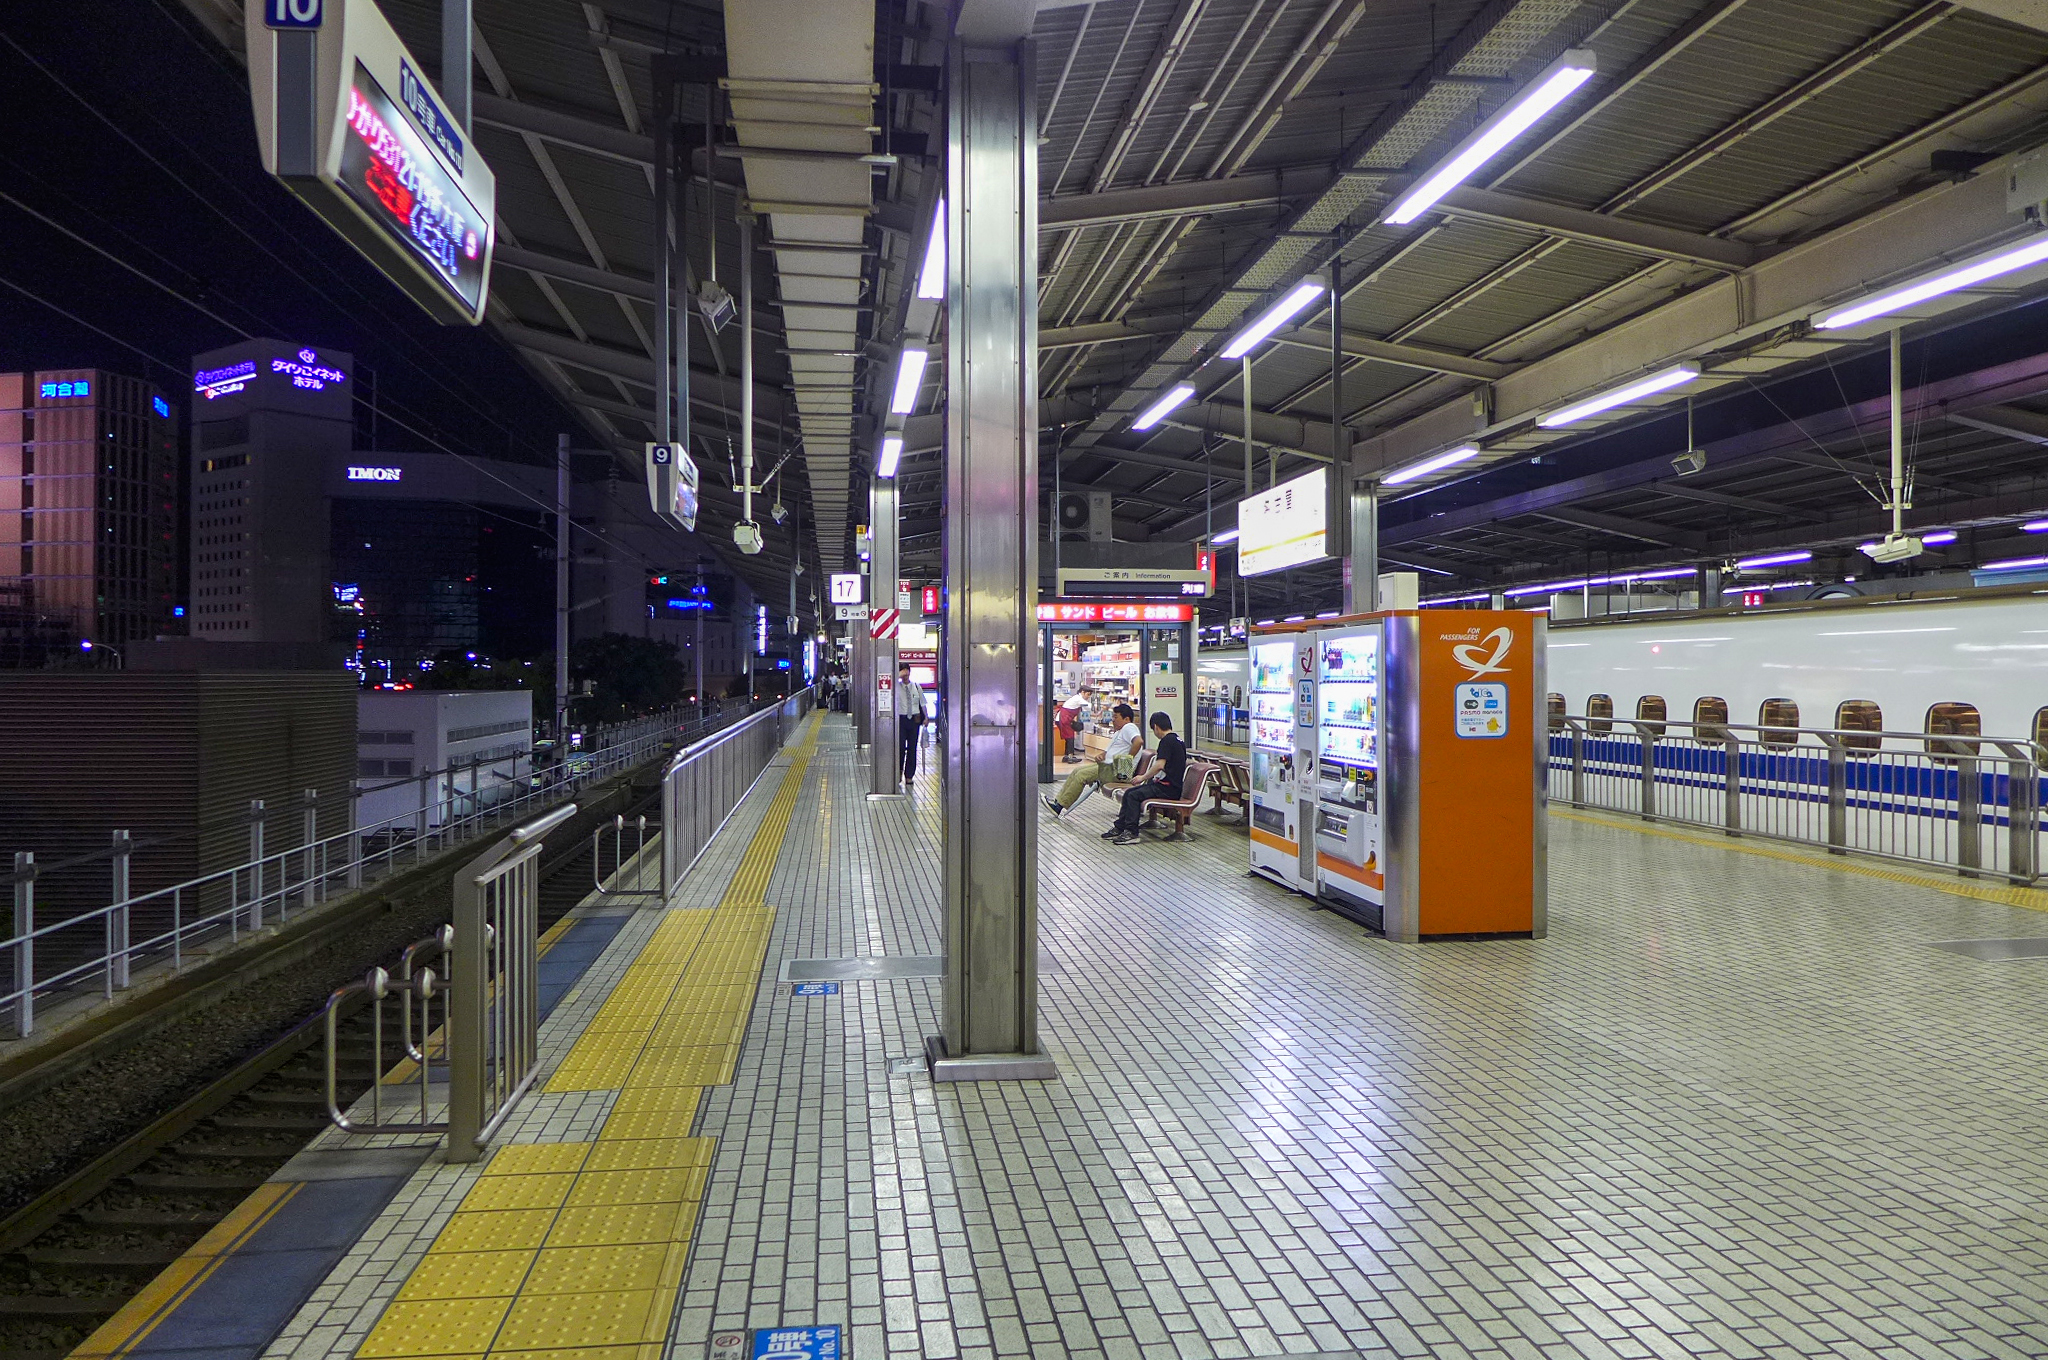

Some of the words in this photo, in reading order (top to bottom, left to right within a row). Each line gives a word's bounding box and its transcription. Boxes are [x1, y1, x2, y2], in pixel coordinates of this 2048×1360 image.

[401, 66, 436, 135] 10号車
[293, 376, 323, 389] ホテル
[41, 382, 89, 398] 河合塾
[656, 447, 668, 463] 9
[348, 467, 401, 481] IMON
[1104, 571, 1129, 579] ご案内
[1135, 572, 1171, 580] Information
[836, 580, 854, 597] 17
[841, 607, 848, 617] 9
[1060, 606, 1095, 619] サンド
[1102, 606, 1138, 619] ビール
